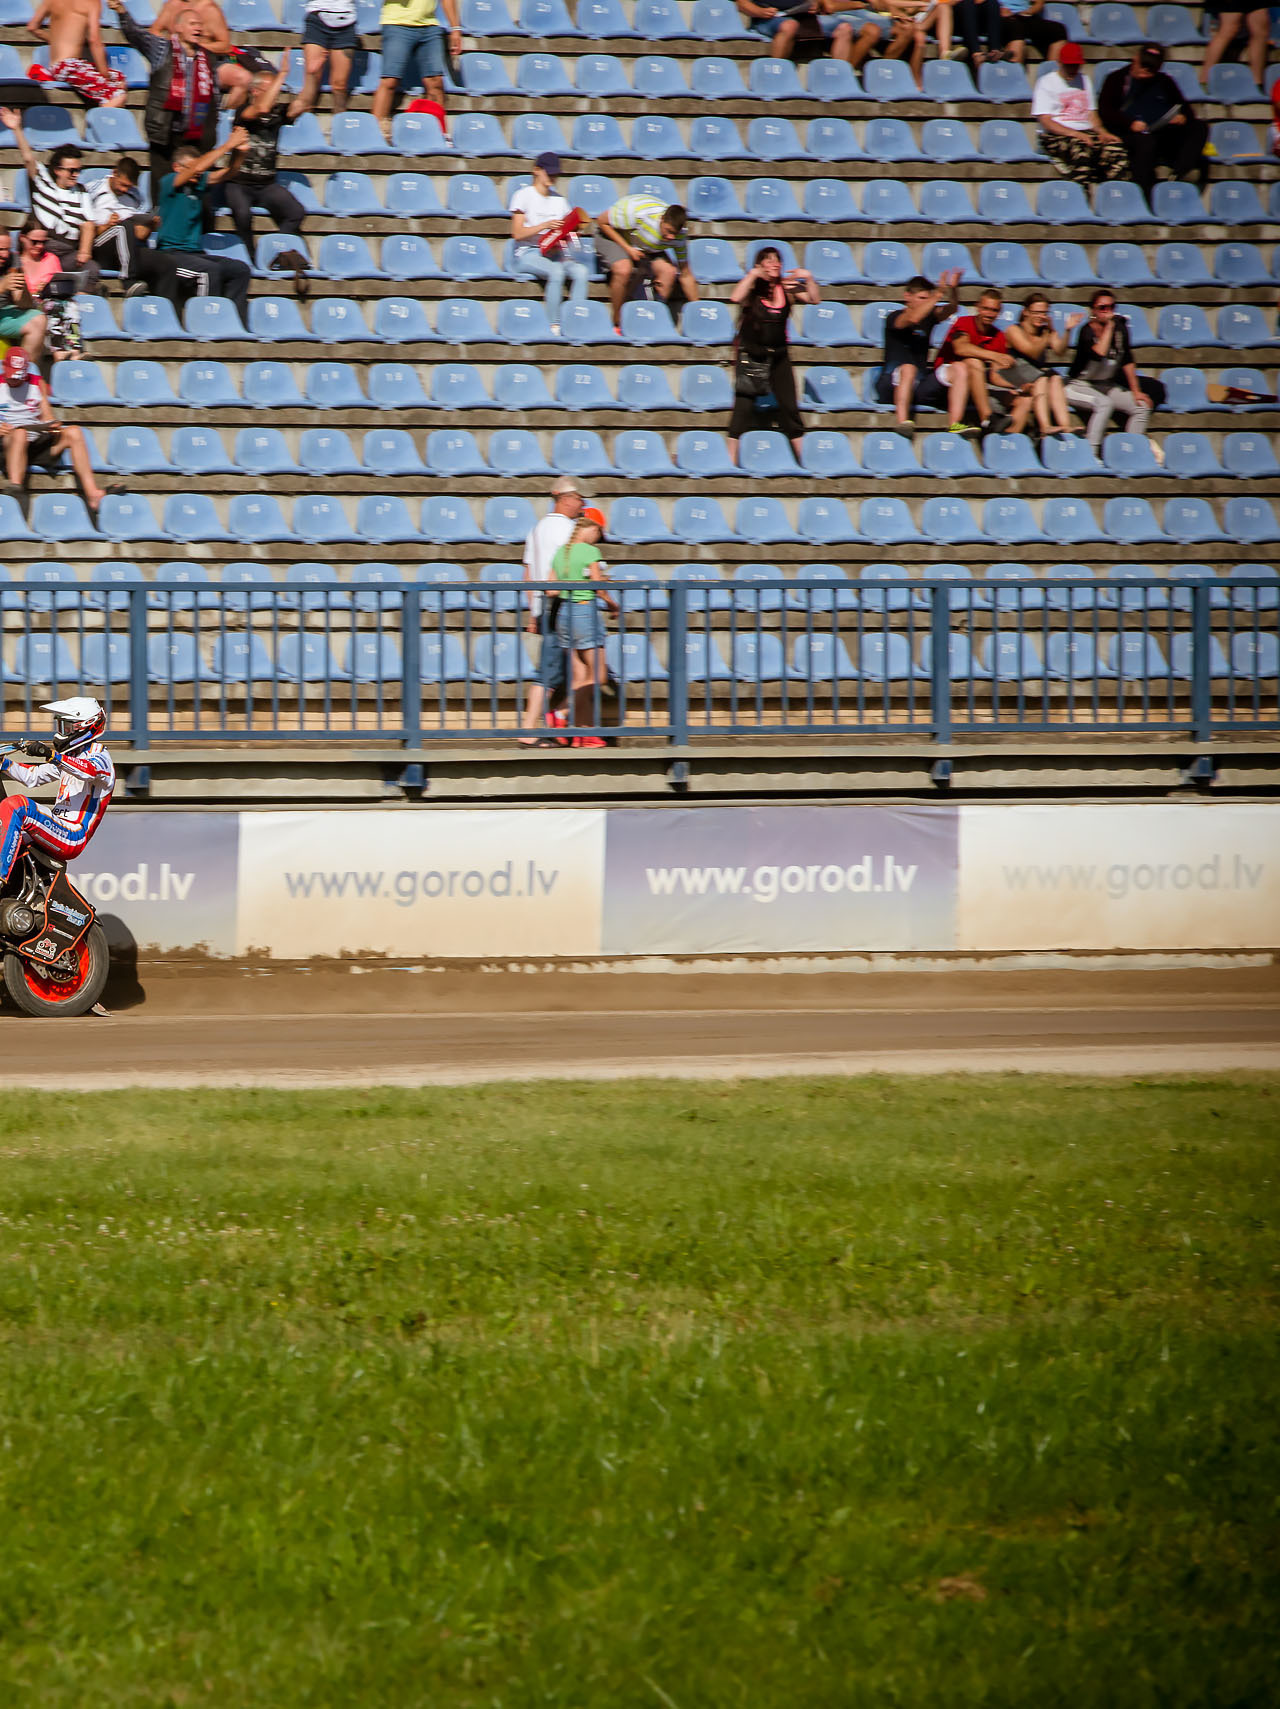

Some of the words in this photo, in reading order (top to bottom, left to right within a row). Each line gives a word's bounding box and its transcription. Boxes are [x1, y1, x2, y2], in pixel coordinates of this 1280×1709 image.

[284, 860, 558, 907] www.gorod.lv
[645, 855, 918, 903] www.gorod.lv
[1001, 854, 1264, 900] www.gorod.lv
